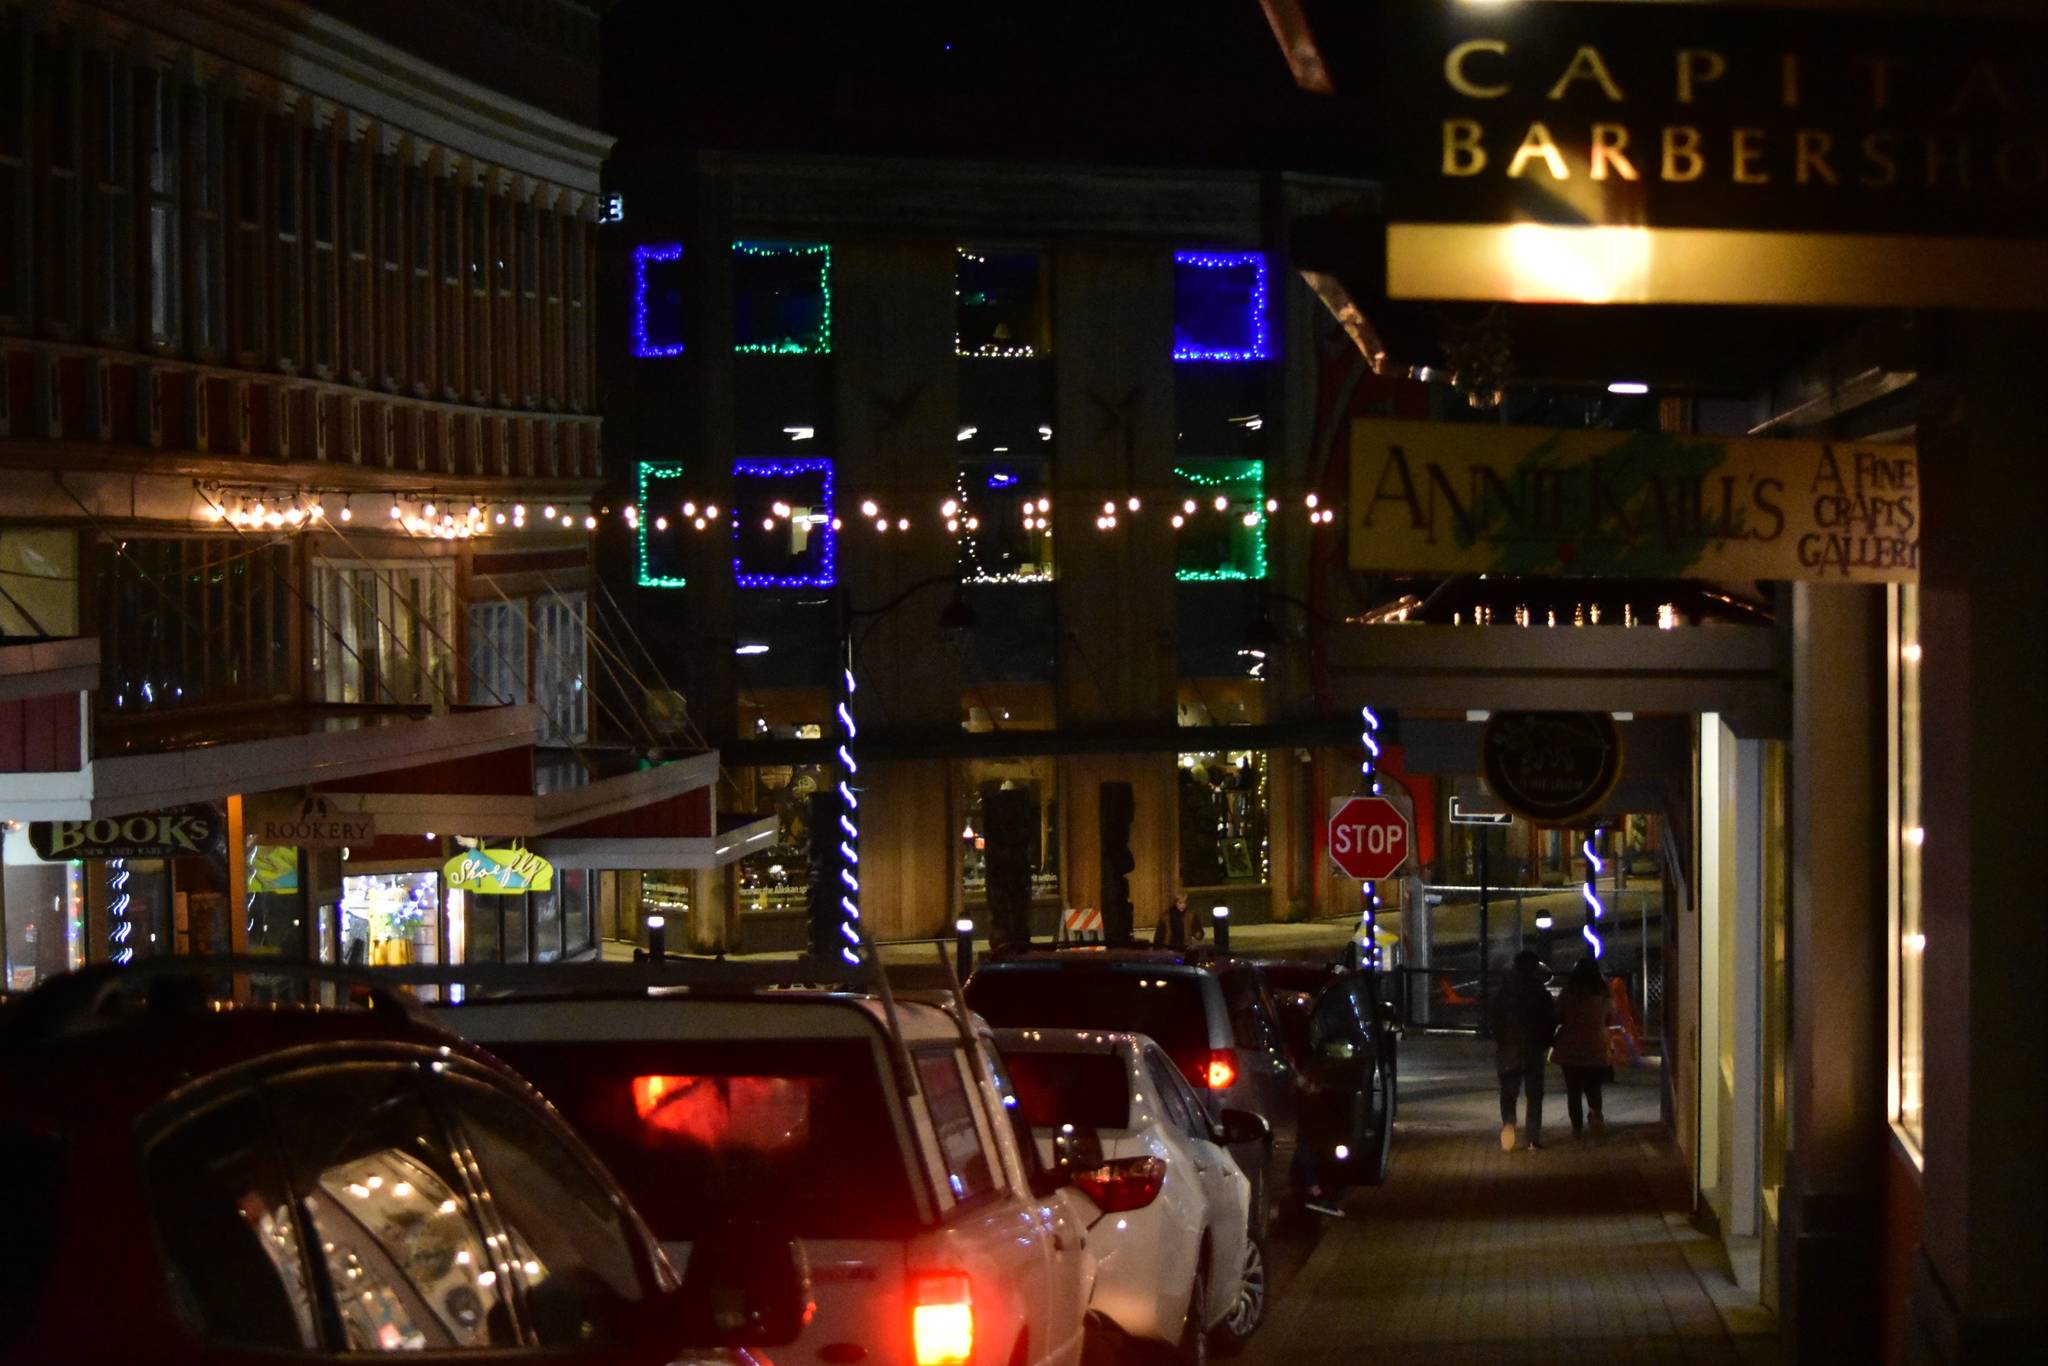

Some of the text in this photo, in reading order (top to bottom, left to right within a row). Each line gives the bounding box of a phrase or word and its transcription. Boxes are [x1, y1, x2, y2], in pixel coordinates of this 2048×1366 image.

[1810, 445, 1914, 494] A FINE
[1813, 495, 1915, 537] CRAFTS
[263, 822, 368, 840] ROOKERY
[1335, 824, 1403, 856] STOP
